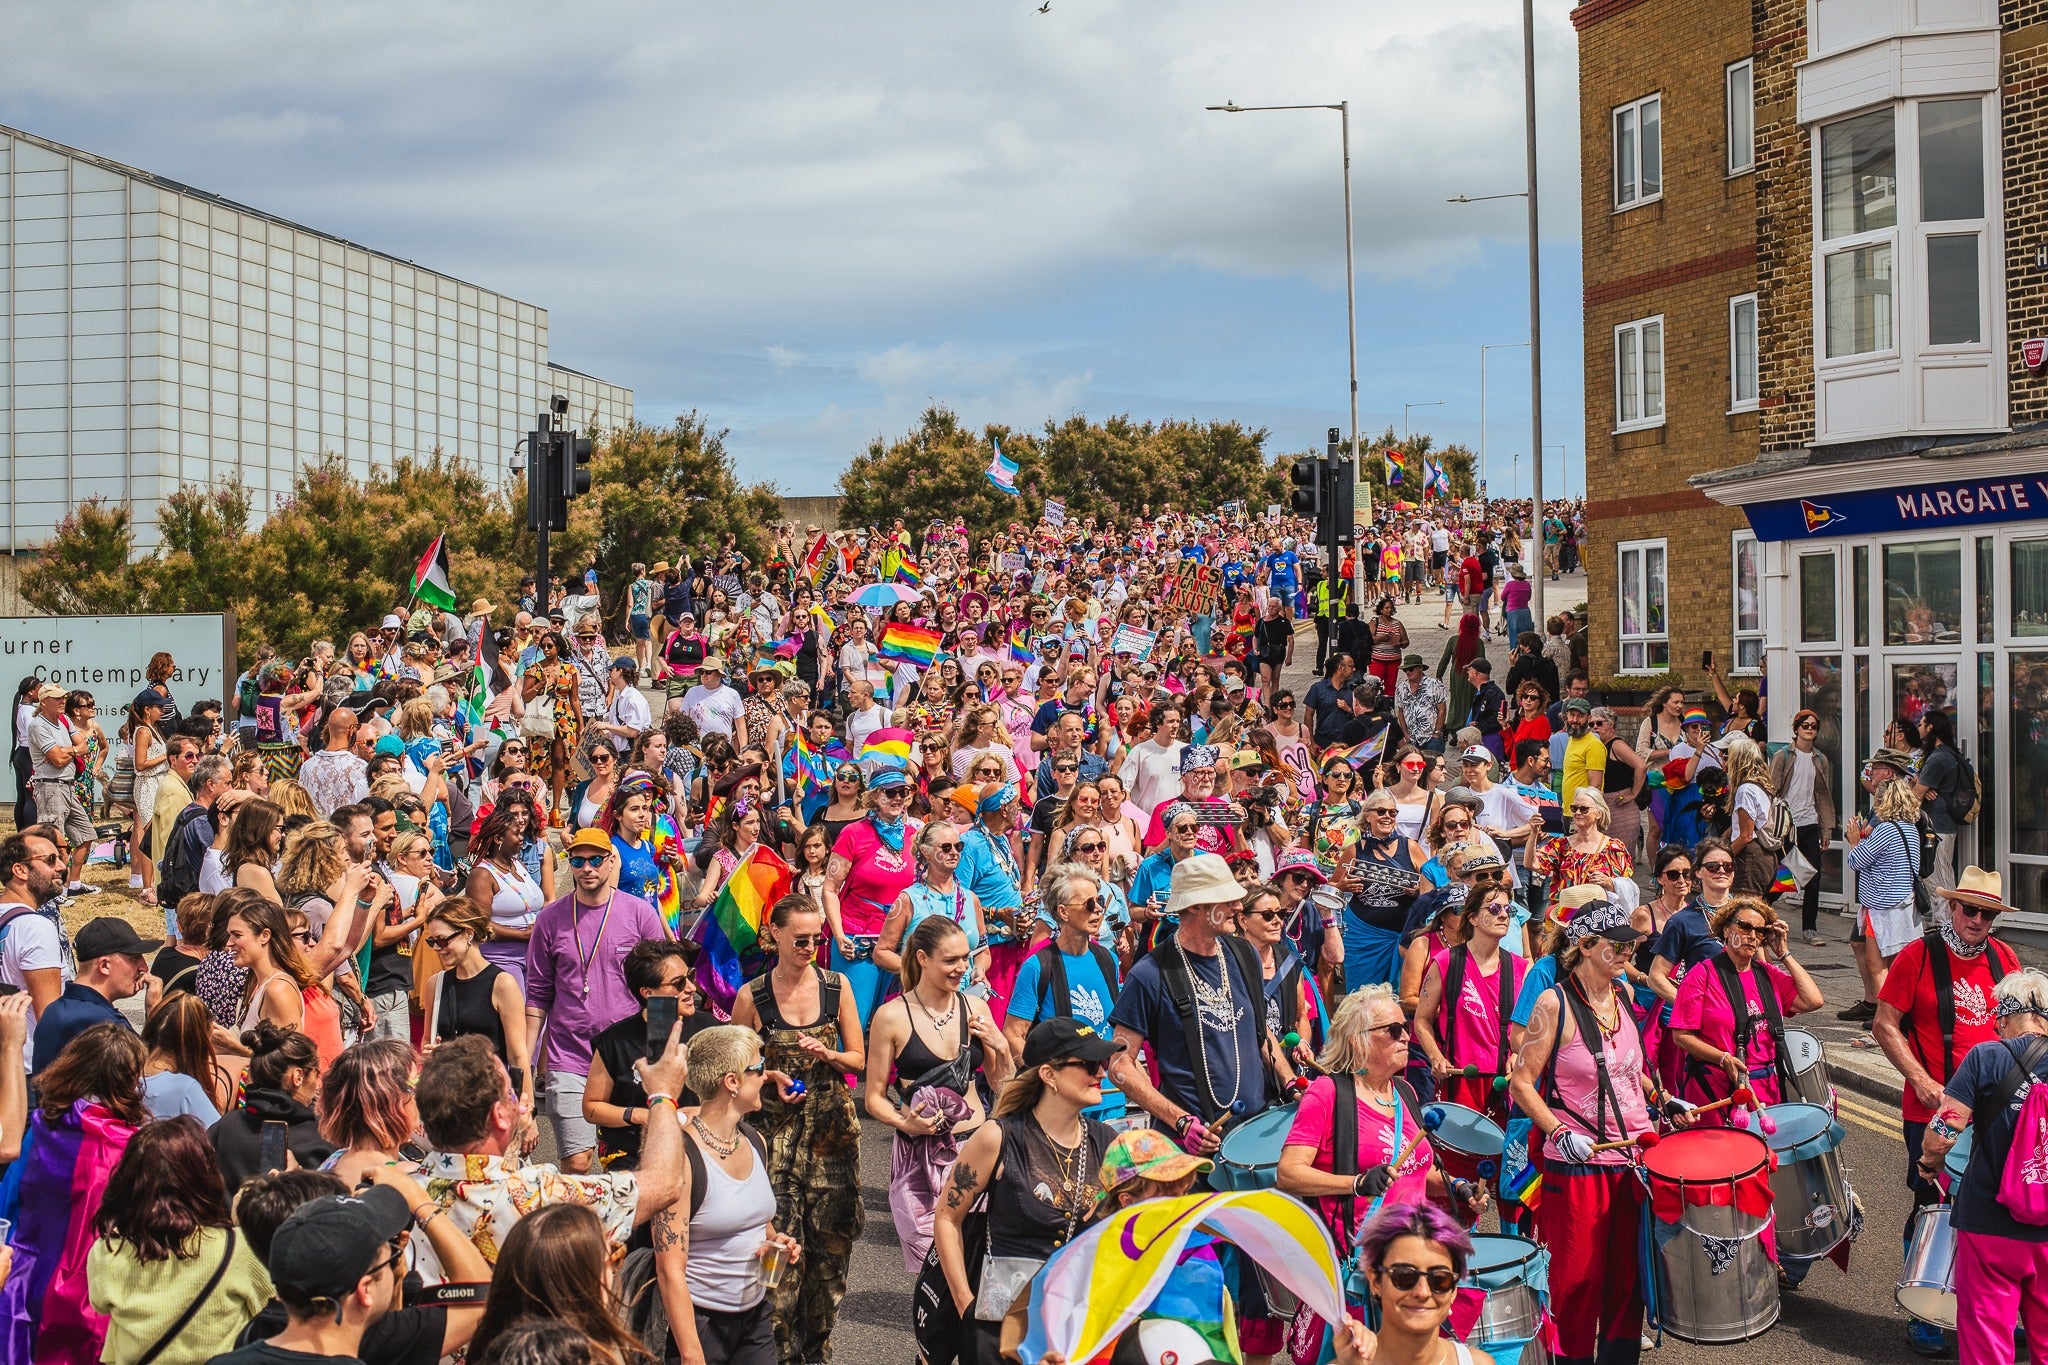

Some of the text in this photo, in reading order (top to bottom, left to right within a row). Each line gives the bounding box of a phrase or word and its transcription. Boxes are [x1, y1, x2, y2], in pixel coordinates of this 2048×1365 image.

[1896, 483, 2030, 519] MARGATE
[1177, 560, 1220, 584] FAGS
[1173, 575, 1218, 597] AGAINST
[1168, 587, 1214, 616] FASCISTS
[0, 637, 74, 654] urner
[34, 664, 210, 687] Contempary
[1801, 1041, 1810, 1058] GOPE
[437, 1288, 475, 1299] Canon
